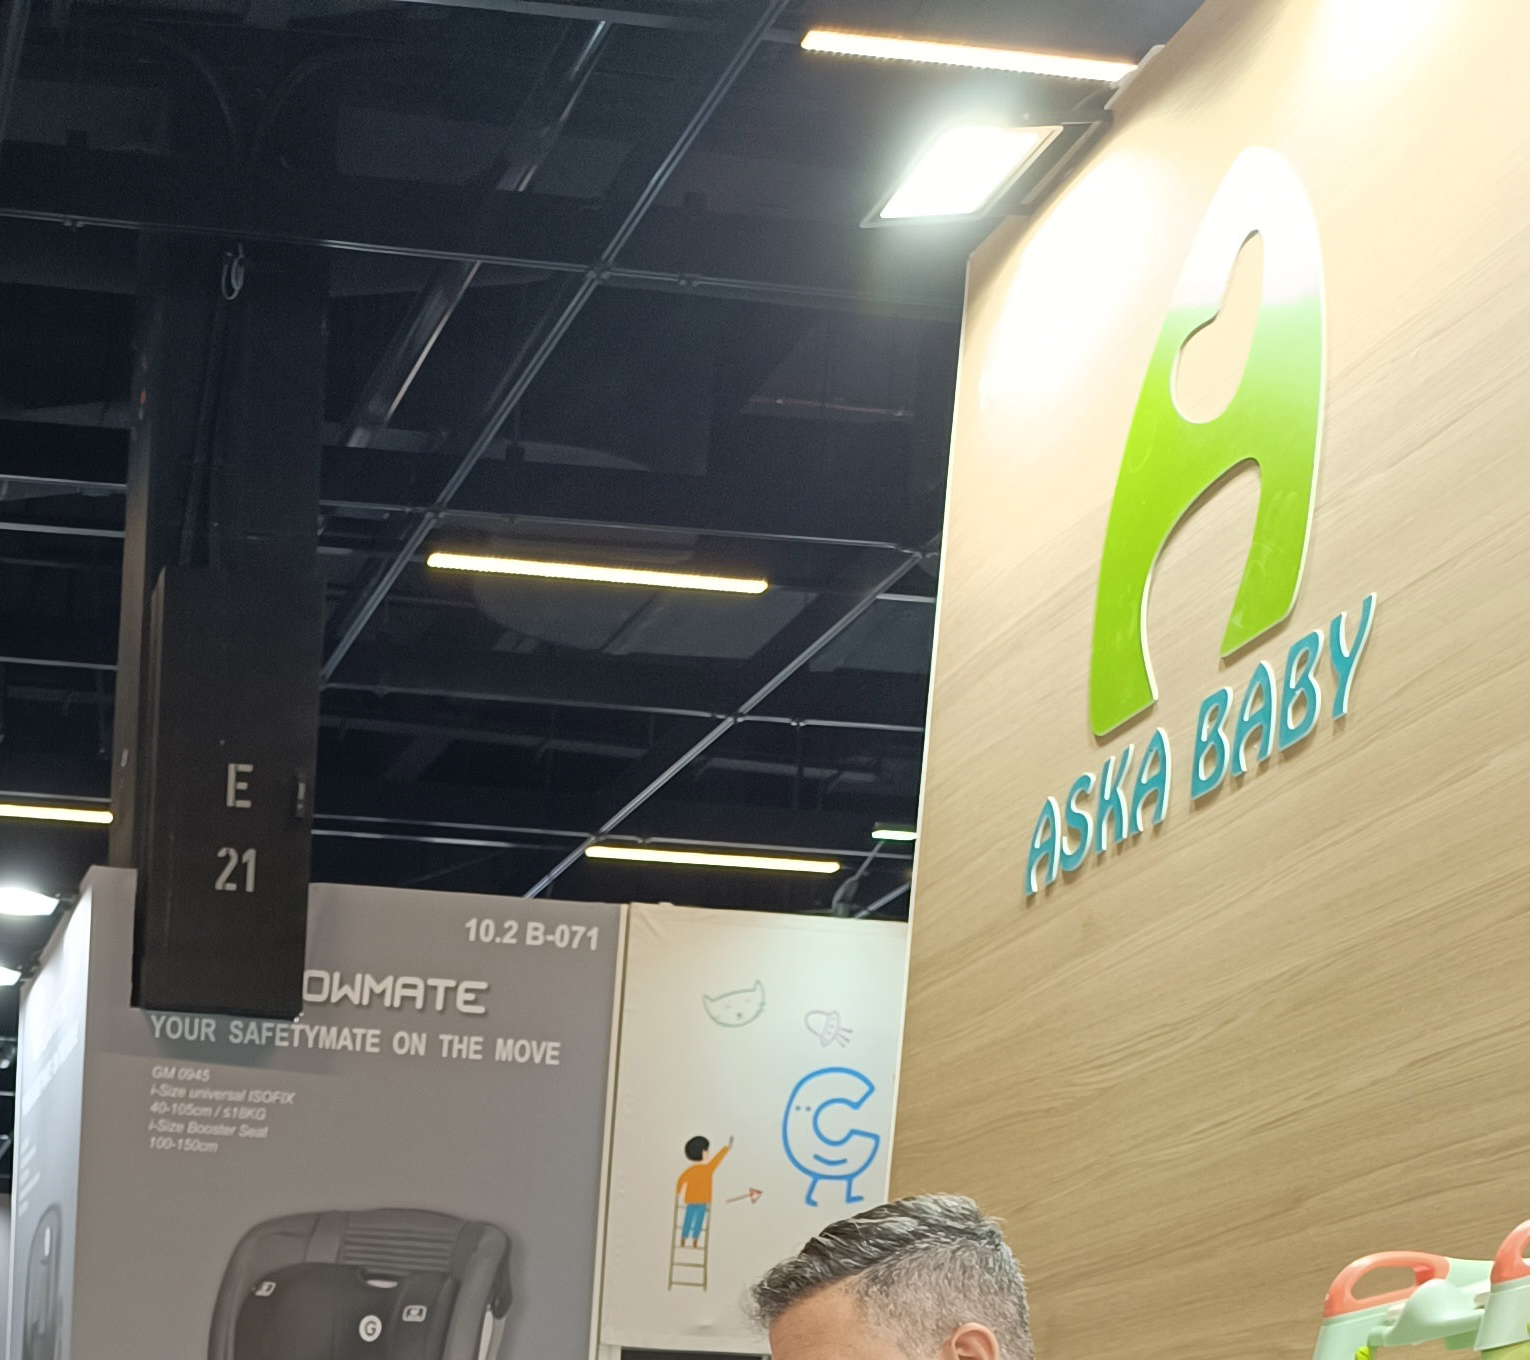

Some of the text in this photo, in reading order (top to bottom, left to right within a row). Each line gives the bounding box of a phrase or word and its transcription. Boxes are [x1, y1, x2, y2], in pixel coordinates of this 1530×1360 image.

[1025, 592, 1378, 897] ASKA BABY
[226, 763, 254, 808] E
[215, 847, 257, 892] 21
[465, 918, 599, 951] 10.2 B-071
[303, 969, 489, 1015] OWMATE
[151, 1014, 562, 1066] YOUR SAFETYMATE ON THE MOVE
[152, 1066, 176, 1080] GM
[189, 1087, 247, 1102] universal
[150, 1136, 219, 1153] 100-150cm
[238, 1123, 269, 1138] Seat
